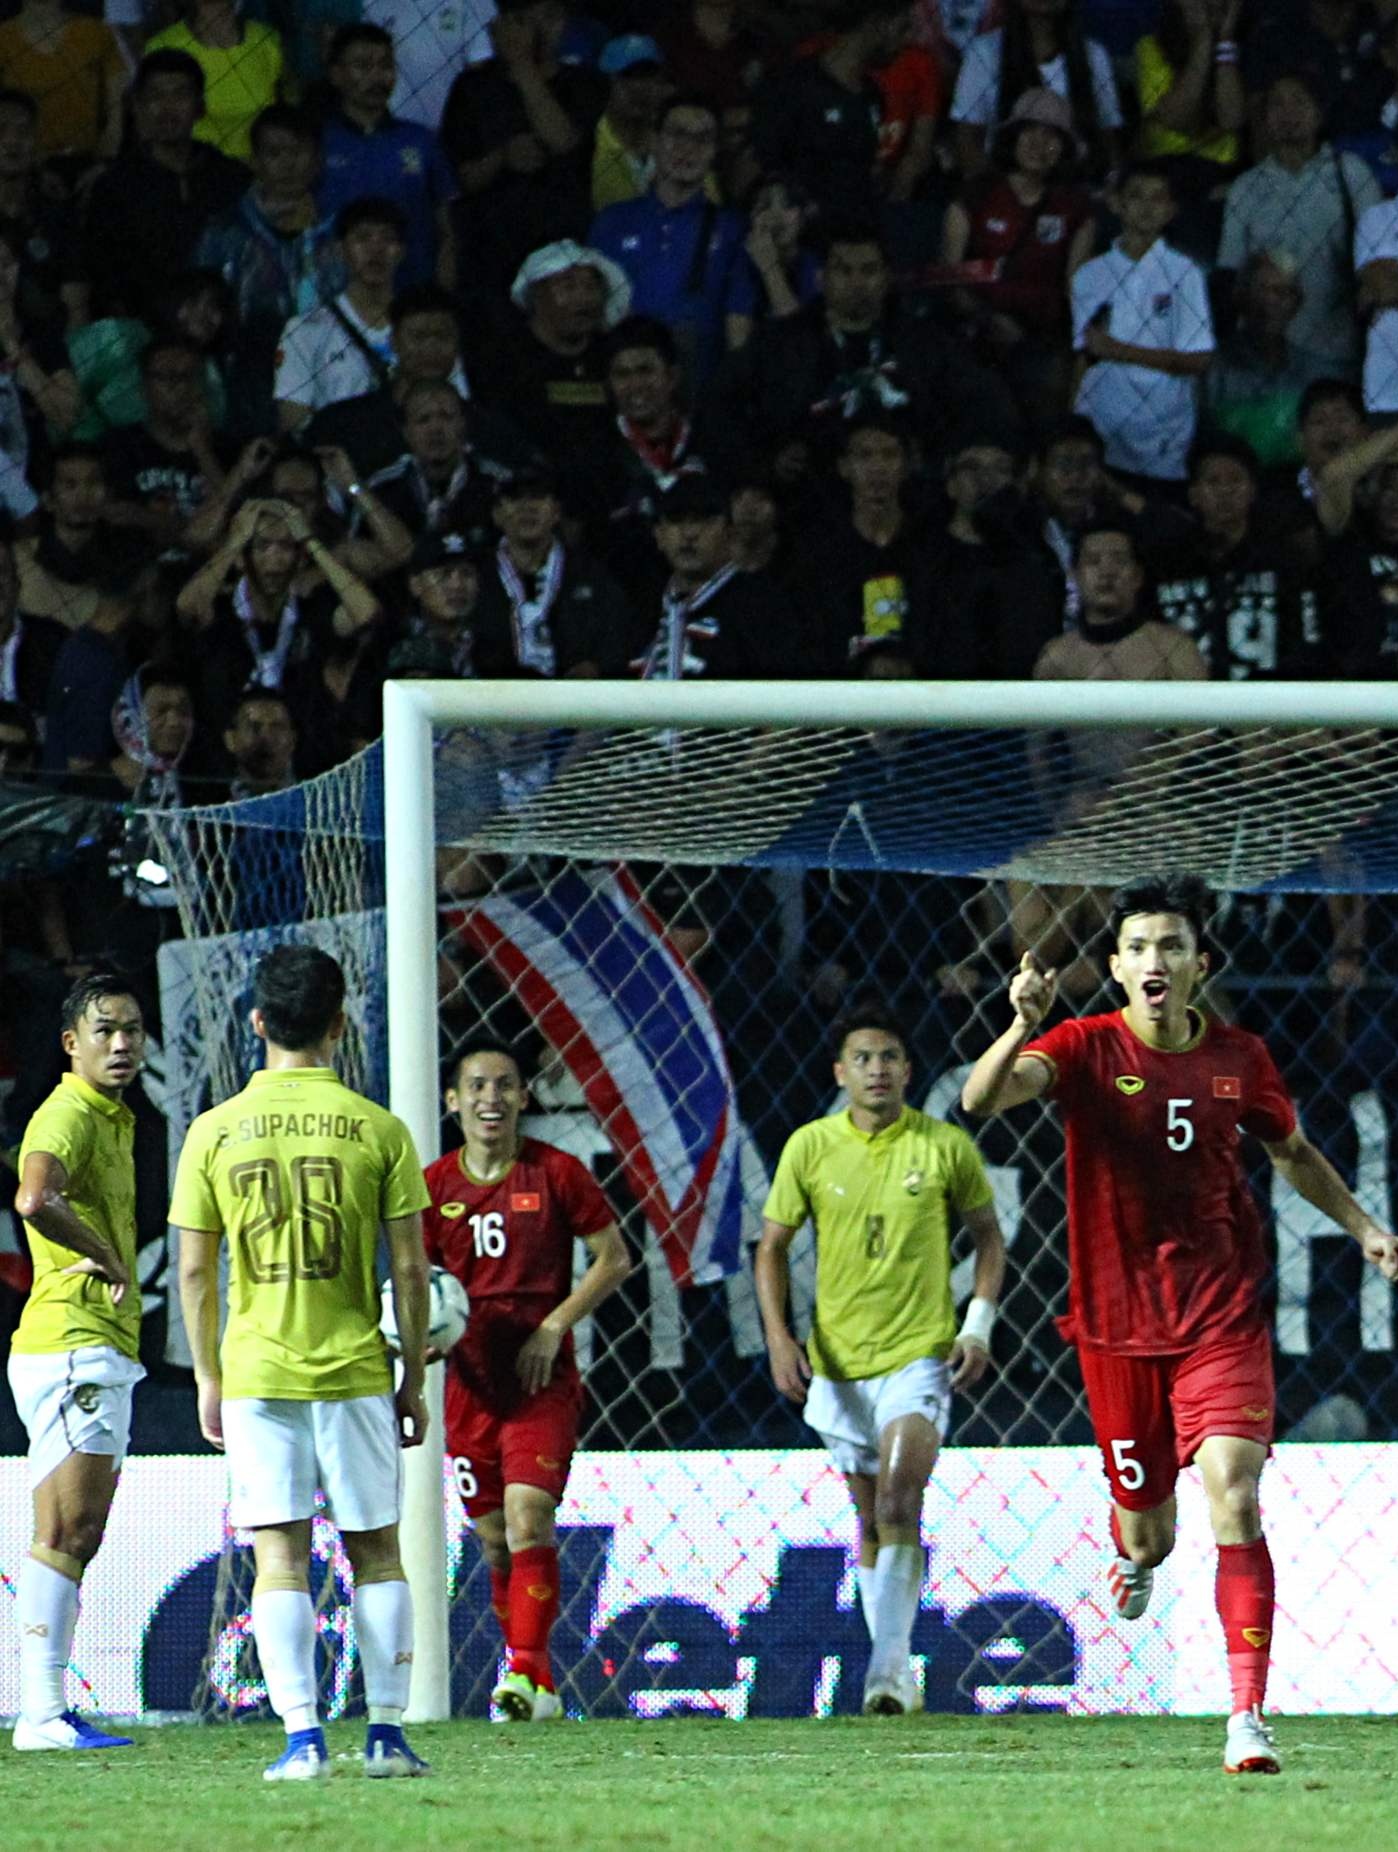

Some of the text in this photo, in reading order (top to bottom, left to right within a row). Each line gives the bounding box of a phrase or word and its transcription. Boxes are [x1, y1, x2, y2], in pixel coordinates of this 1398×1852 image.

[1166, 1098, 1194, 1152] 5
[467, 1211, 507, 1259] 16
[1110, 1439, 1146, 1491] 5
